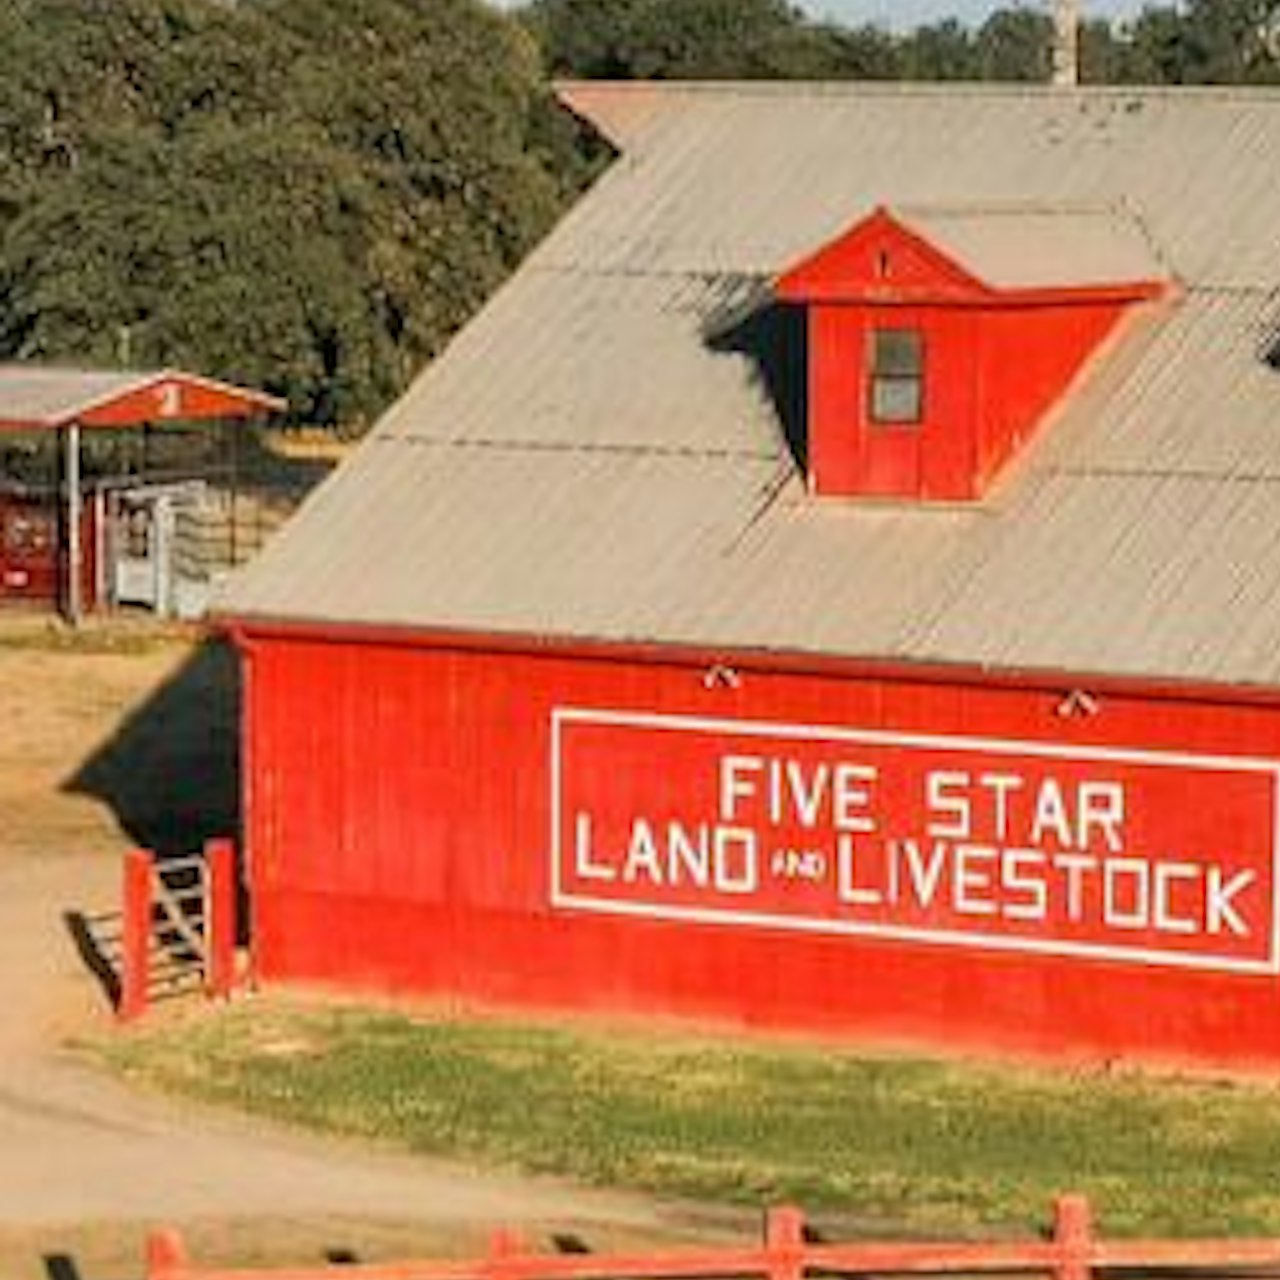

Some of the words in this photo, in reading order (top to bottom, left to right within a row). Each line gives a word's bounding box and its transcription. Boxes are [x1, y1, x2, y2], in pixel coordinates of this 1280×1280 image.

[720, 755, 878, 832] FIVE
[925, 771, 1124, 853] STAR
[575, 813, 759, 894] LAND
[770, 851, 826, 879] AND
[837, 835, 1255, 936] LIVESTOCK
